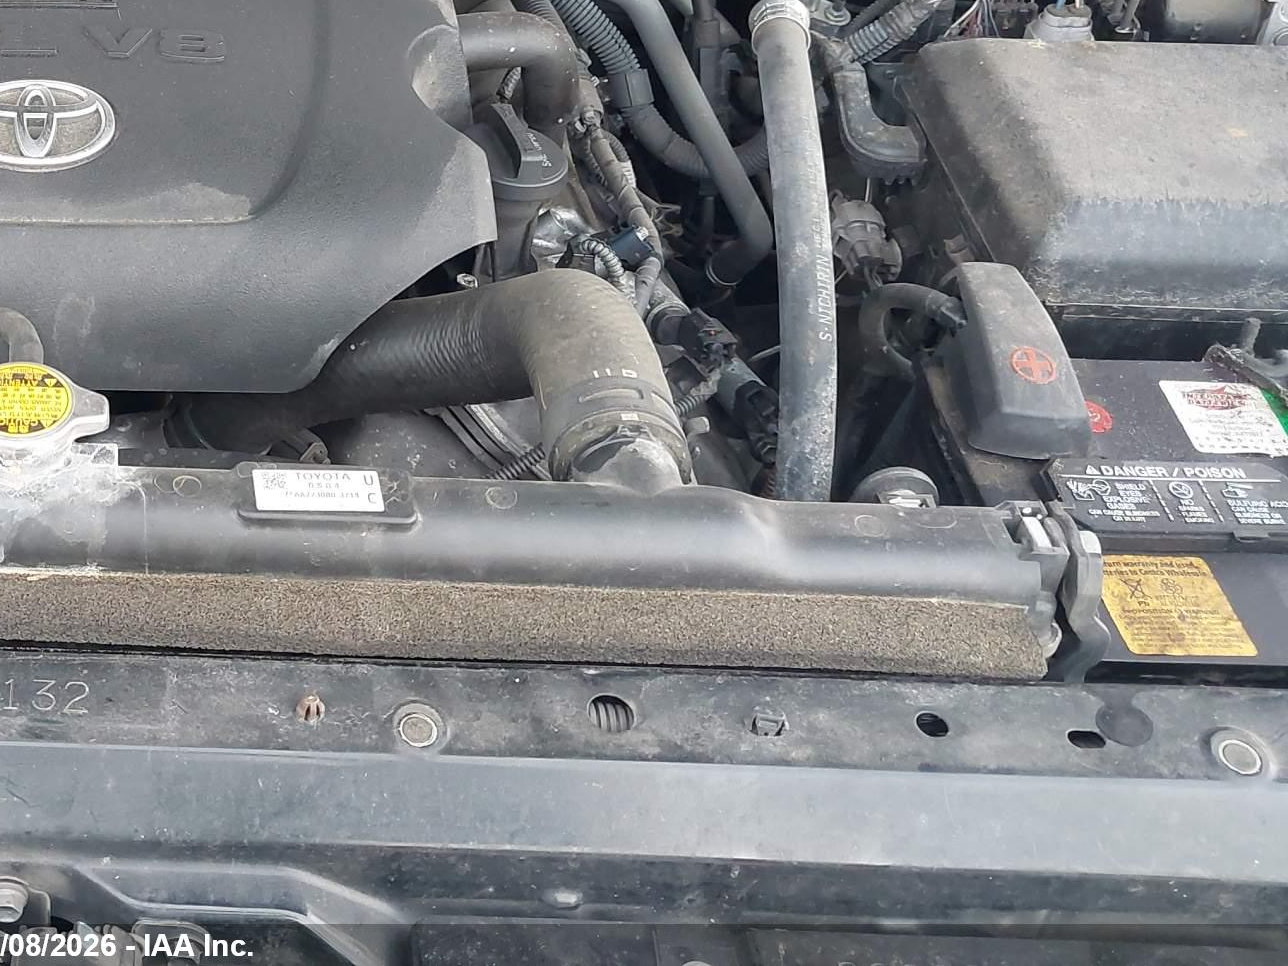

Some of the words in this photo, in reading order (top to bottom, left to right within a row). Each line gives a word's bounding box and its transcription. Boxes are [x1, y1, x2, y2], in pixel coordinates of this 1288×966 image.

[83, 28, 226, 62] V8
[296, 472, 351, 481] TOYOTA
[1100, 465, 1170, 477] DANGER
[1183, 467, 1247, 479] POISON
[363, 474, 374, 486] U
[368, 492, 377, 504] C
